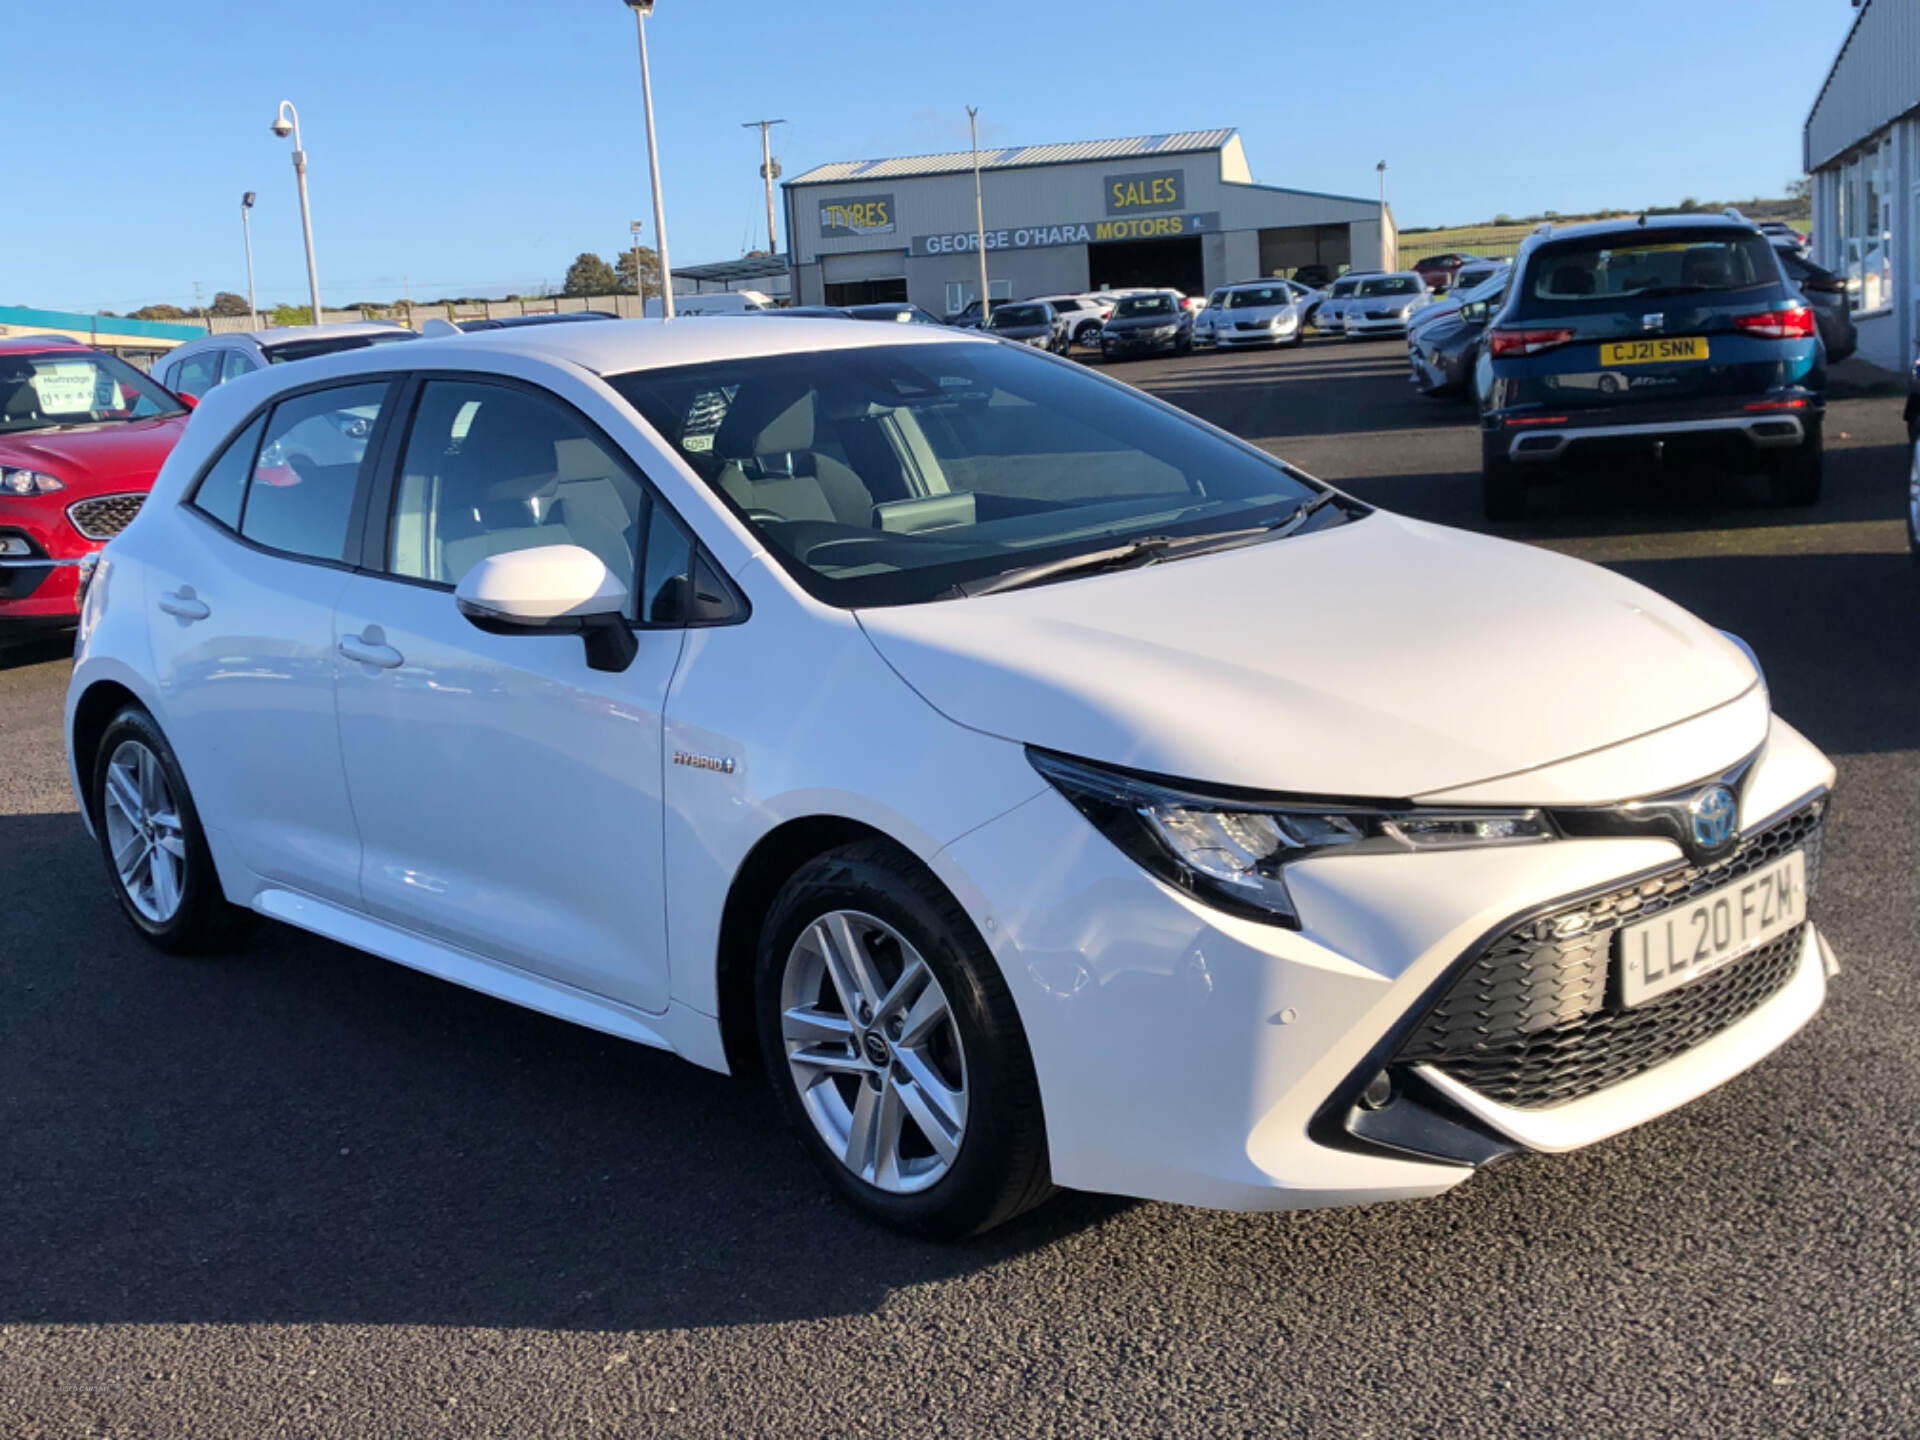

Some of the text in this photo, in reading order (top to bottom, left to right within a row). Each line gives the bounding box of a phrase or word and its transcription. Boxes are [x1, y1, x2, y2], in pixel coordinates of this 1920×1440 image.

[1112, 177, 1177, 207] SALES
[826, 201, 888, 229] TYRES
[926, 215, 1183, 253] GEORGE O'HARA MOTORS
[1612, 338, 1695, 361] CJ21 SNN
[672, 751, 723, 772] HYBRID
[1641, 864, 1793, 986] LL20 FZM
